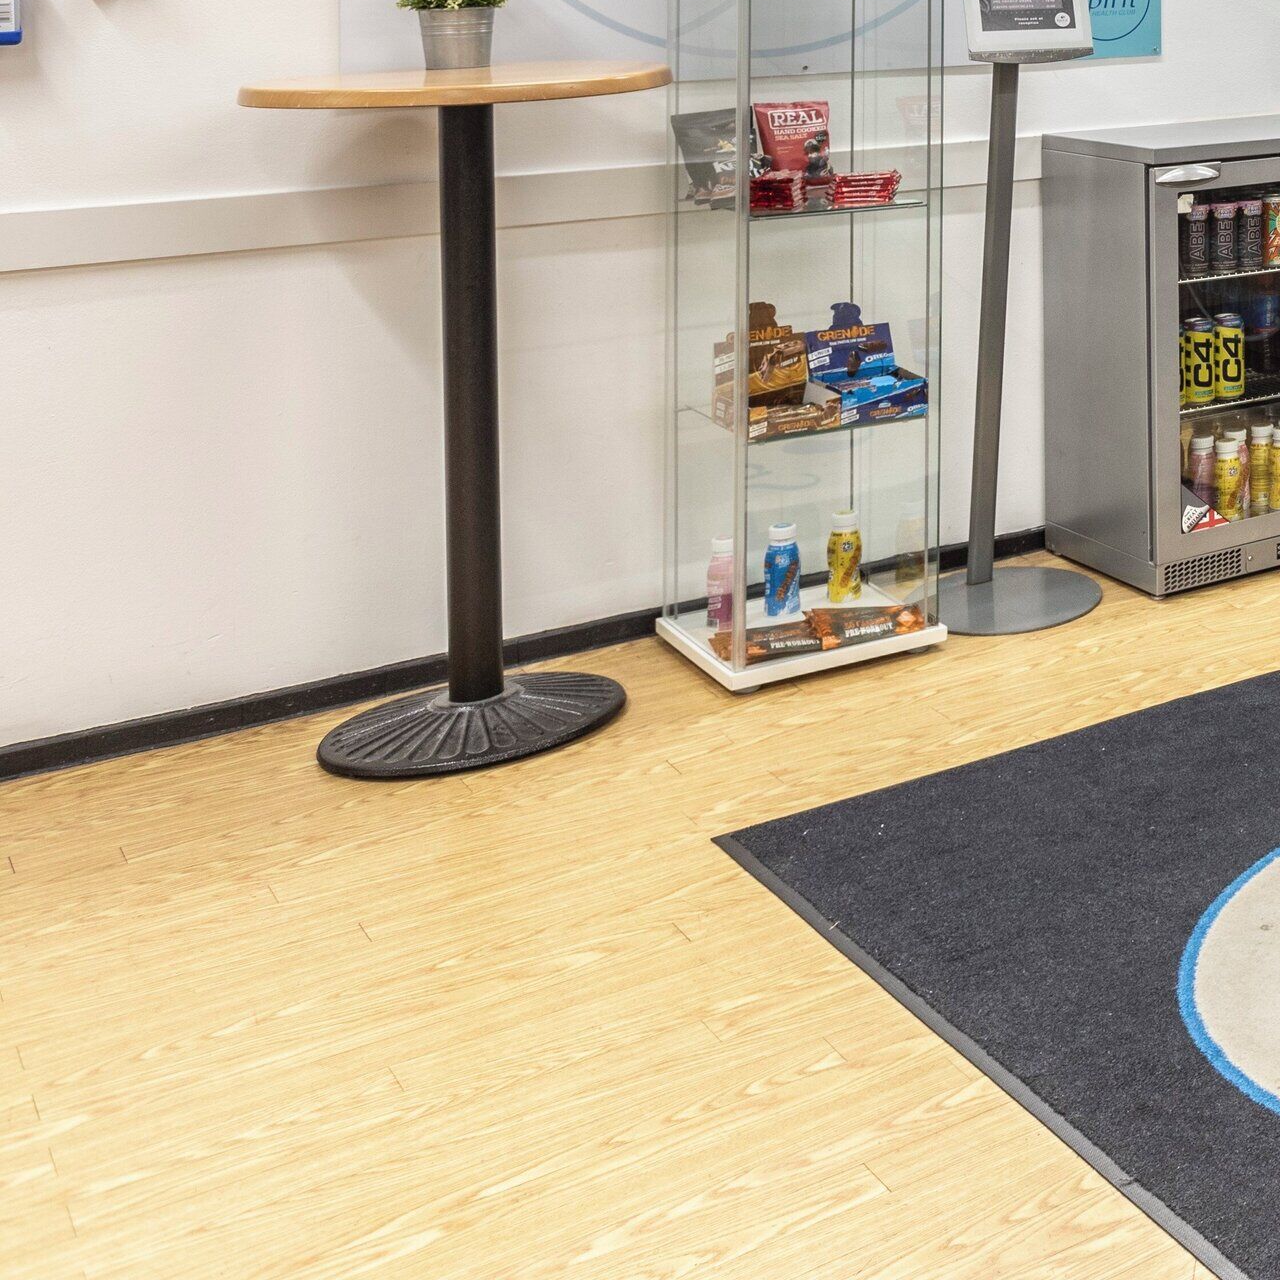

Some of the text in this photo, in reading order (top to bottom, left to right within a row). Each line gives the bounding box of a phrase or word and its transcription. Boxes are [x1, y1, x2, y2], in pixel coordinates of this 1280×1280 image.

[772, 110, 823, 127] REAL
[1190, 221, 1206, 261] ABE
[1218, 219, 1233, 259] ABE
[1247, 216, 1262, 258] ABE
[1193, 337, 1213, 388] C4
[1223, 334, 1242, 383] C4
[1183, 509, 1199, 525] GREAT
[1186, 511, 1204, 529] BRITAIN
[844, 622, 894, 638] PRE-WORKOUT
